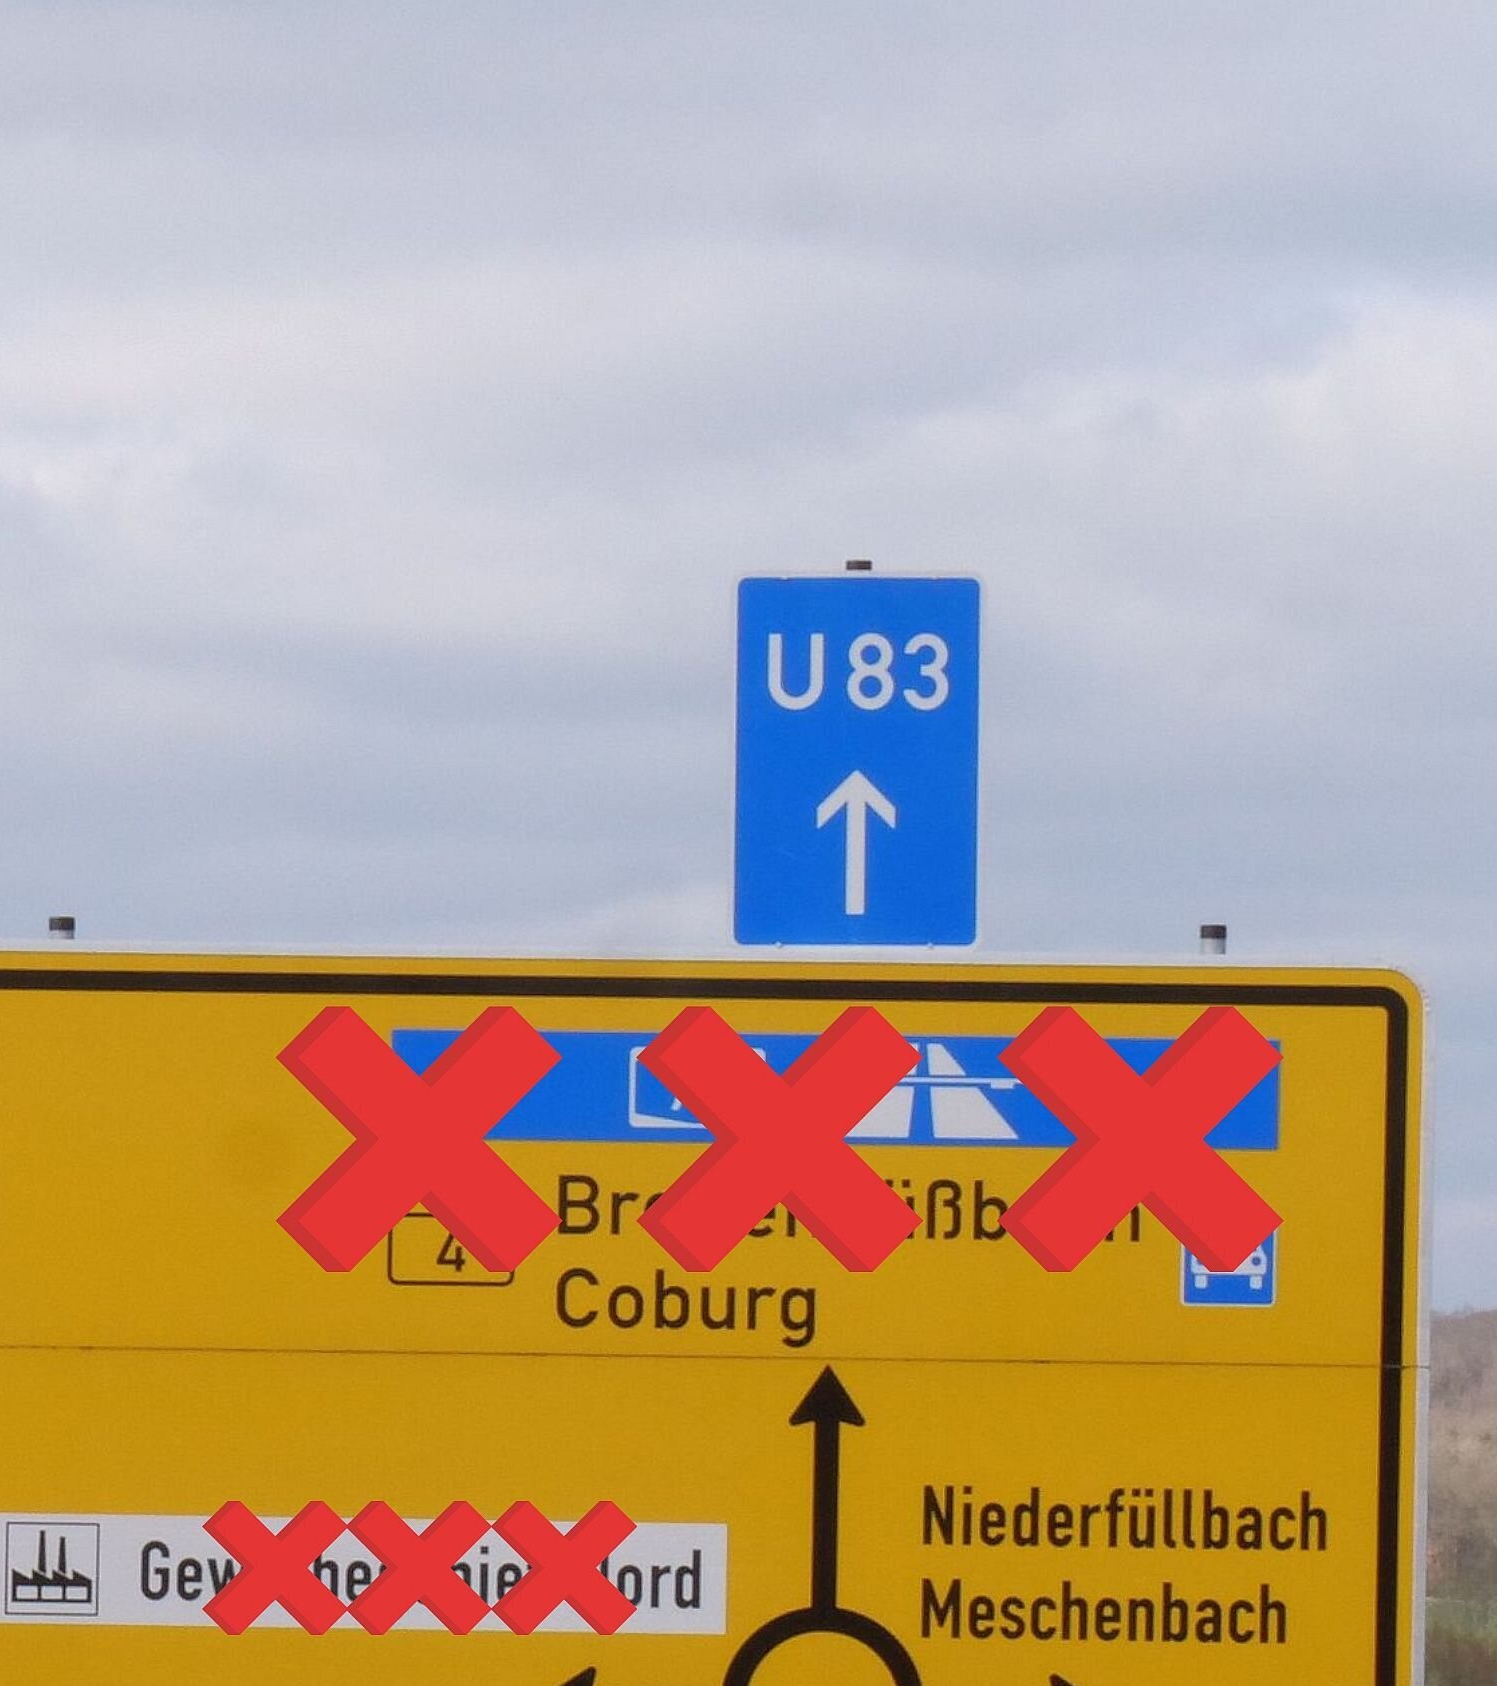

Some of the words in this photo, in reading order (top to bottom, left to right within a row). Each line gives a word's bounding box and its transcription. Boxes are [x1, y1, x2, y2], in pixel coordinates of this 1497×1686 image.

[768, 633, 825, 711] U
[847, 632, 949, 711] 83
[556, 1267, 816, 1348] Coburg
[923, 1485, 1328, 1551] Niederfüllbach
[598, 1549, 701, 1609] ord
[920, 1578, 1287, 1644] Meschenbach
